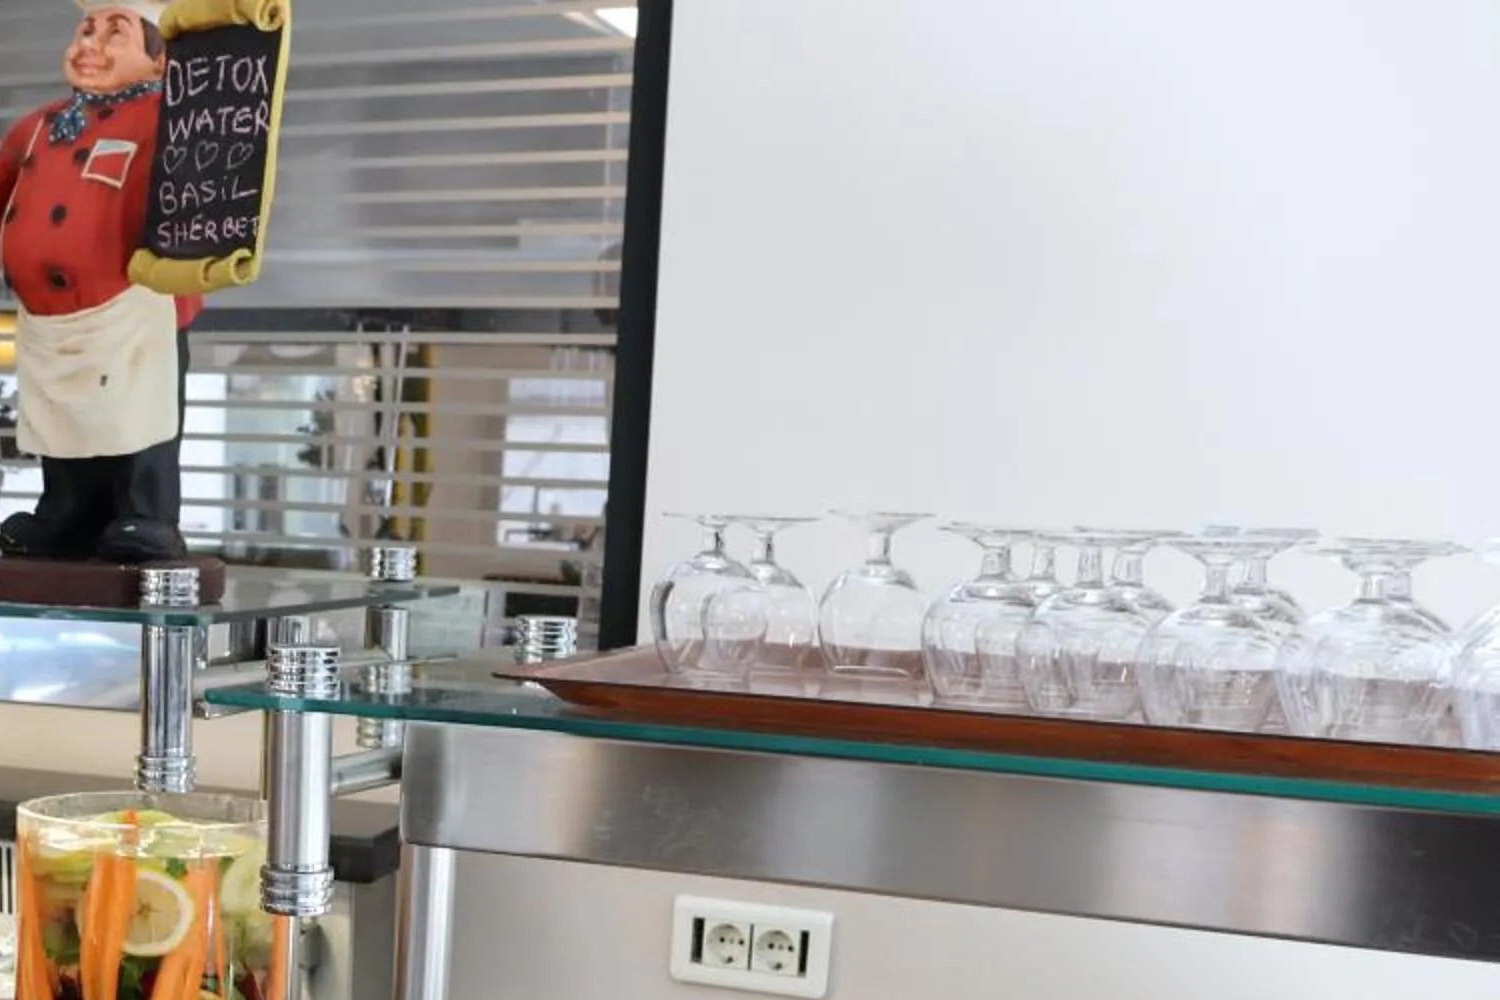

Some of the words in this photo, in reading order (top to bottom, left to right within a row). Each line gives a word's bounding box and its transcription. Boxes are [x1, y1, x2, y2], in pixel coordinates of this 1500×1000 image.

[165, 55, 269, 107] DETOX
[168, 100, 269, 144] WATER
[157, 214, 260, 249] SHERBET
